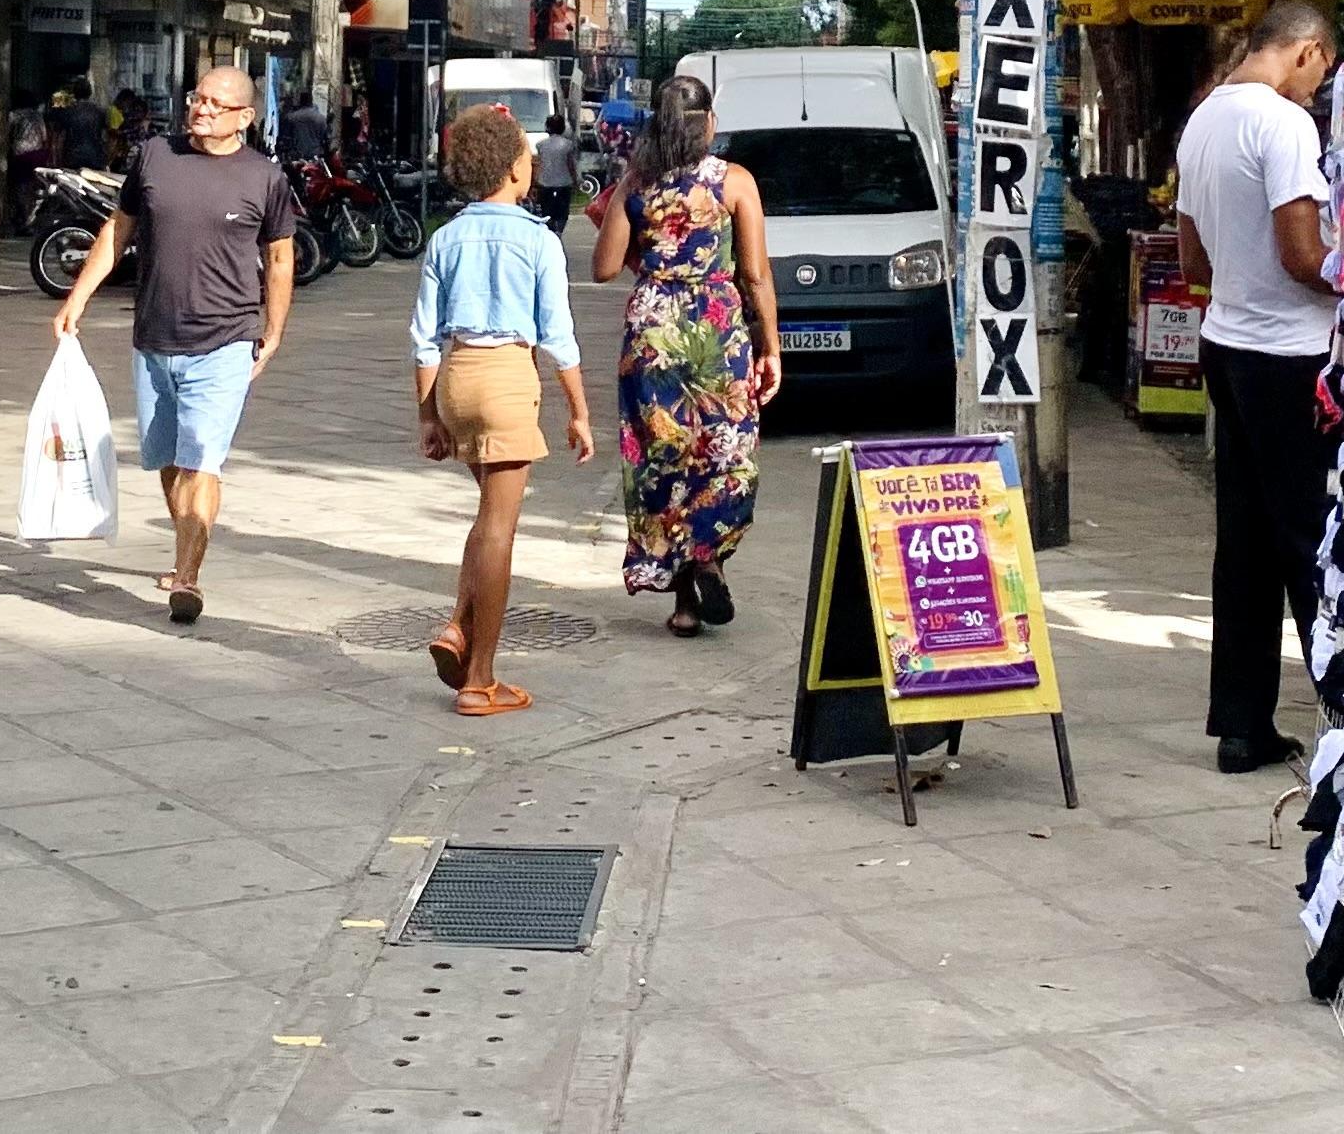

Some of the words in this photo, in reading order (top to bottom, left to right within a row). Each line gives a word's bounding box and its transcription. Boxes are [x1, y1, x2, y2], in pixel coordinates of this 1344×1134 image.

[1160, 308, 1188, 323] 7GB
[778, 332, 843, 350] RU2B56
[876, 474, 921, 495] VOCÊ
[940, 472, 981, 492] BEM
[943, 489, 981, 512] PRÉ
[908, 524, 980, 564] 4GB
